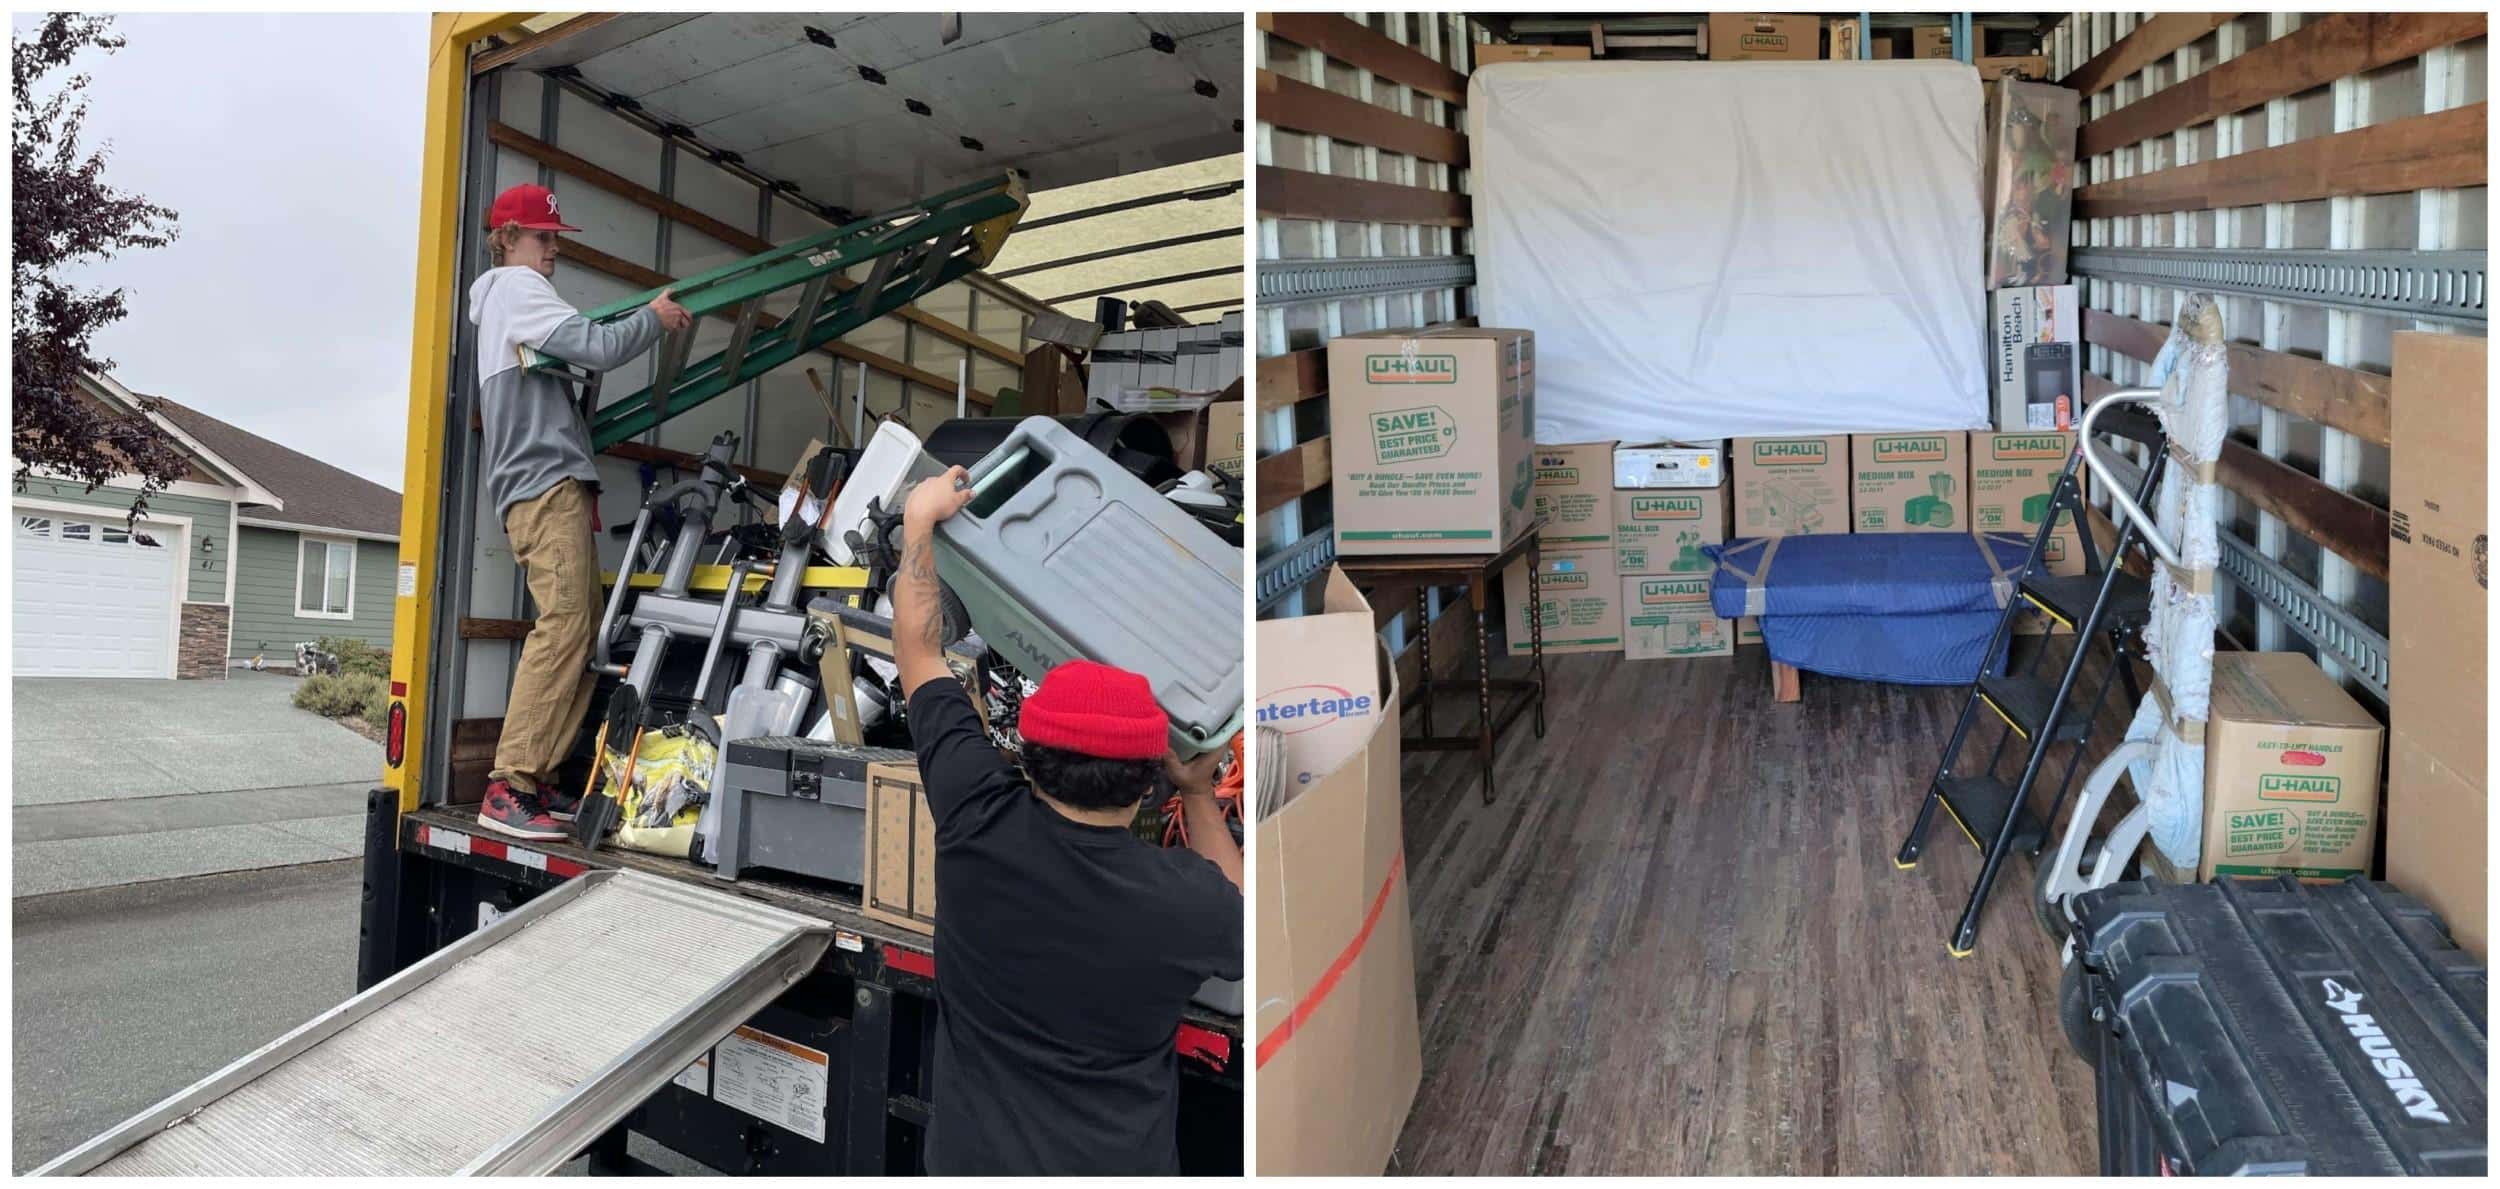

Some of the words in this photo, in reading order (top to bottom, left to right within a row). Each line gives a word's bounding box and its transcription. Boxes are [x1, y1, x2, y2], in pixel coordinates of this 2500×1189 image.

[1744, 37, 1785, 46] U-HAUL
[546, 194, 560, 215] R
[2012, 296, 2023, 343] Beach
[2003, 314, 2014, 382] Hamilton
[1372, 359, 1451, 373] U-HAUL
[1376, 412, 1436, 432] SAVE!
[1379, 437, 1405, 449] BEST
[1408, 433, 1438, 446] PRICE
[1879, 440, 1942, 454] U-HAUL
[1997, 439, 2061, 451] U-HAUL
[1380, 444, 1441, 459] GUARANTEED
[1758, 444, 1823, 456] U-HAUL
[1217, 459, 1243, 472] SAV
[1858, 472, 1894, 481] MEDIUM
[1898, 471, 1914, 480] BOX
[1977, 469, 2013, 478] MEDIUM
[1635, 499, 1697, 512] U-HAUL
[1541, 575, 1585, 585] U-HAUL
[1645, 583, 1707, 596] U-HAUL
[1256, 695, 1370, 721] ntertape
[2265, 778, 2336, 793] U-HAUL
[2231, 812, 2284, 829] SAVE!
[2231, 834, 2253, 844] BEST
[2256, 831, 2283, 842] PRICE
[2231, 842, 2284, 852] GUARANTEED
[2341, 1013, 2451, 1124] HUSKY
